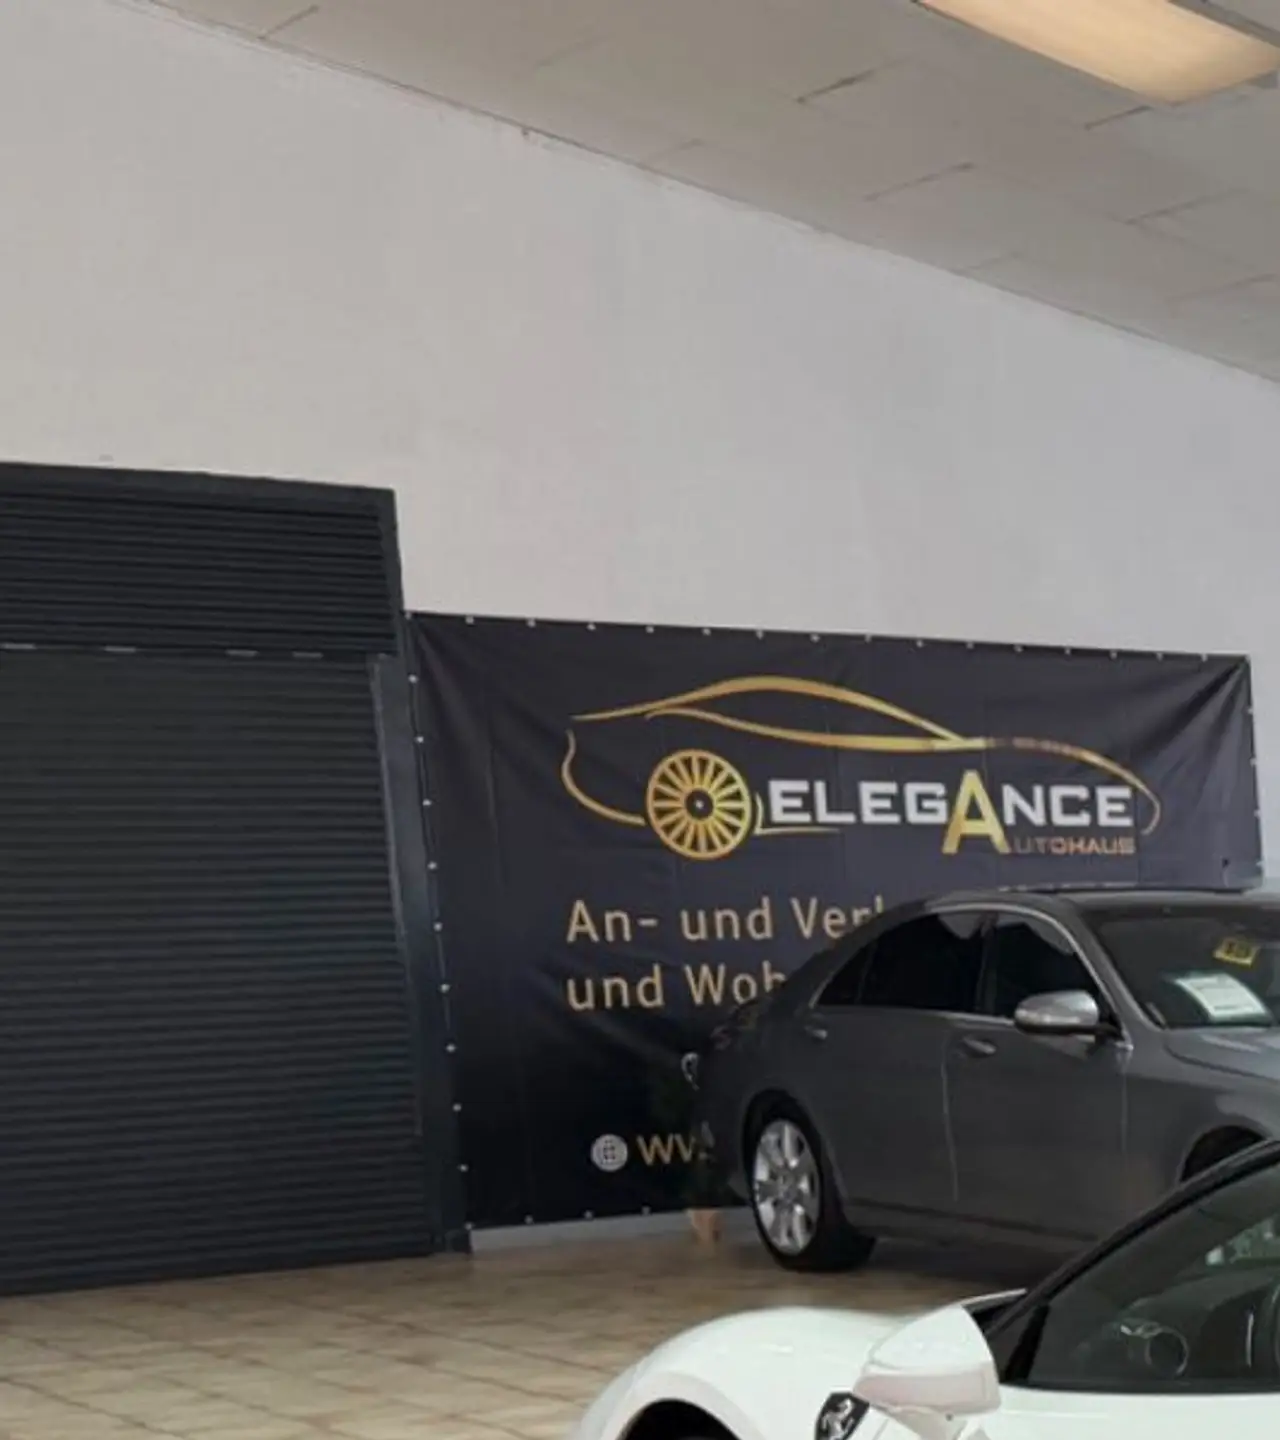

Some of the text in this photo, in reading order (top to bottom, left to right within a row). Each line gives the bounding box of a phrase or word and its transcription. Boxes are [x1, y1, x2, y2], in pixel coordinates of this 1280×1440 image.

[767, 769, 1134, 855] ELEGANCE
[566, 899, 658, 943] An-
[680, 896, 773, 941] und
[566, 963, 665, 1011] und
